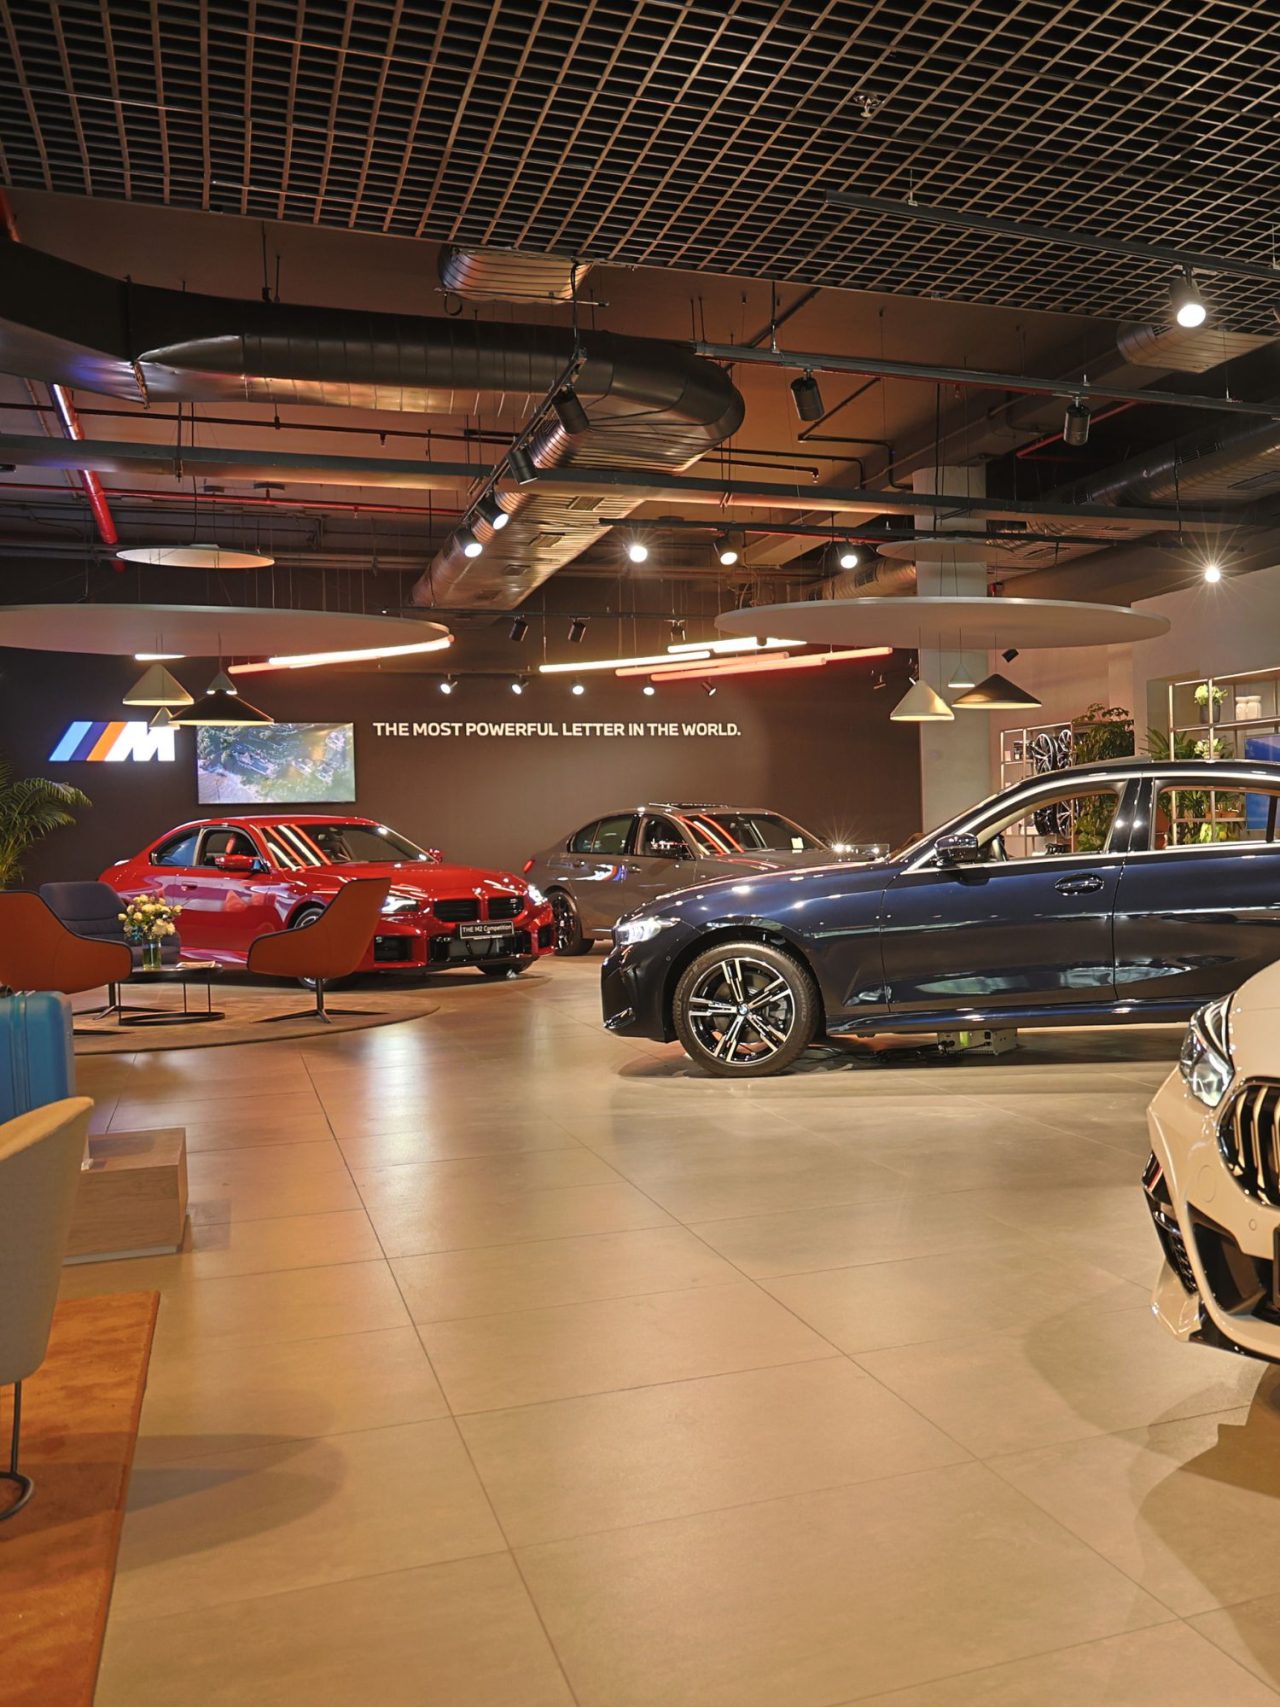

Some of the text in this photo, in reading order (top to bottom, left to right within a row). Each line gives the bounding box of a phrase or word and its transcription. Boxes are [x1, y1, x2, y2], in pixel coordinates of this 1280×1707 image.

[372, 722, 742, 737] THE MOST POWERFUL LETTER IN THE WORLD.
[483, 924, 513, 932] Competition
